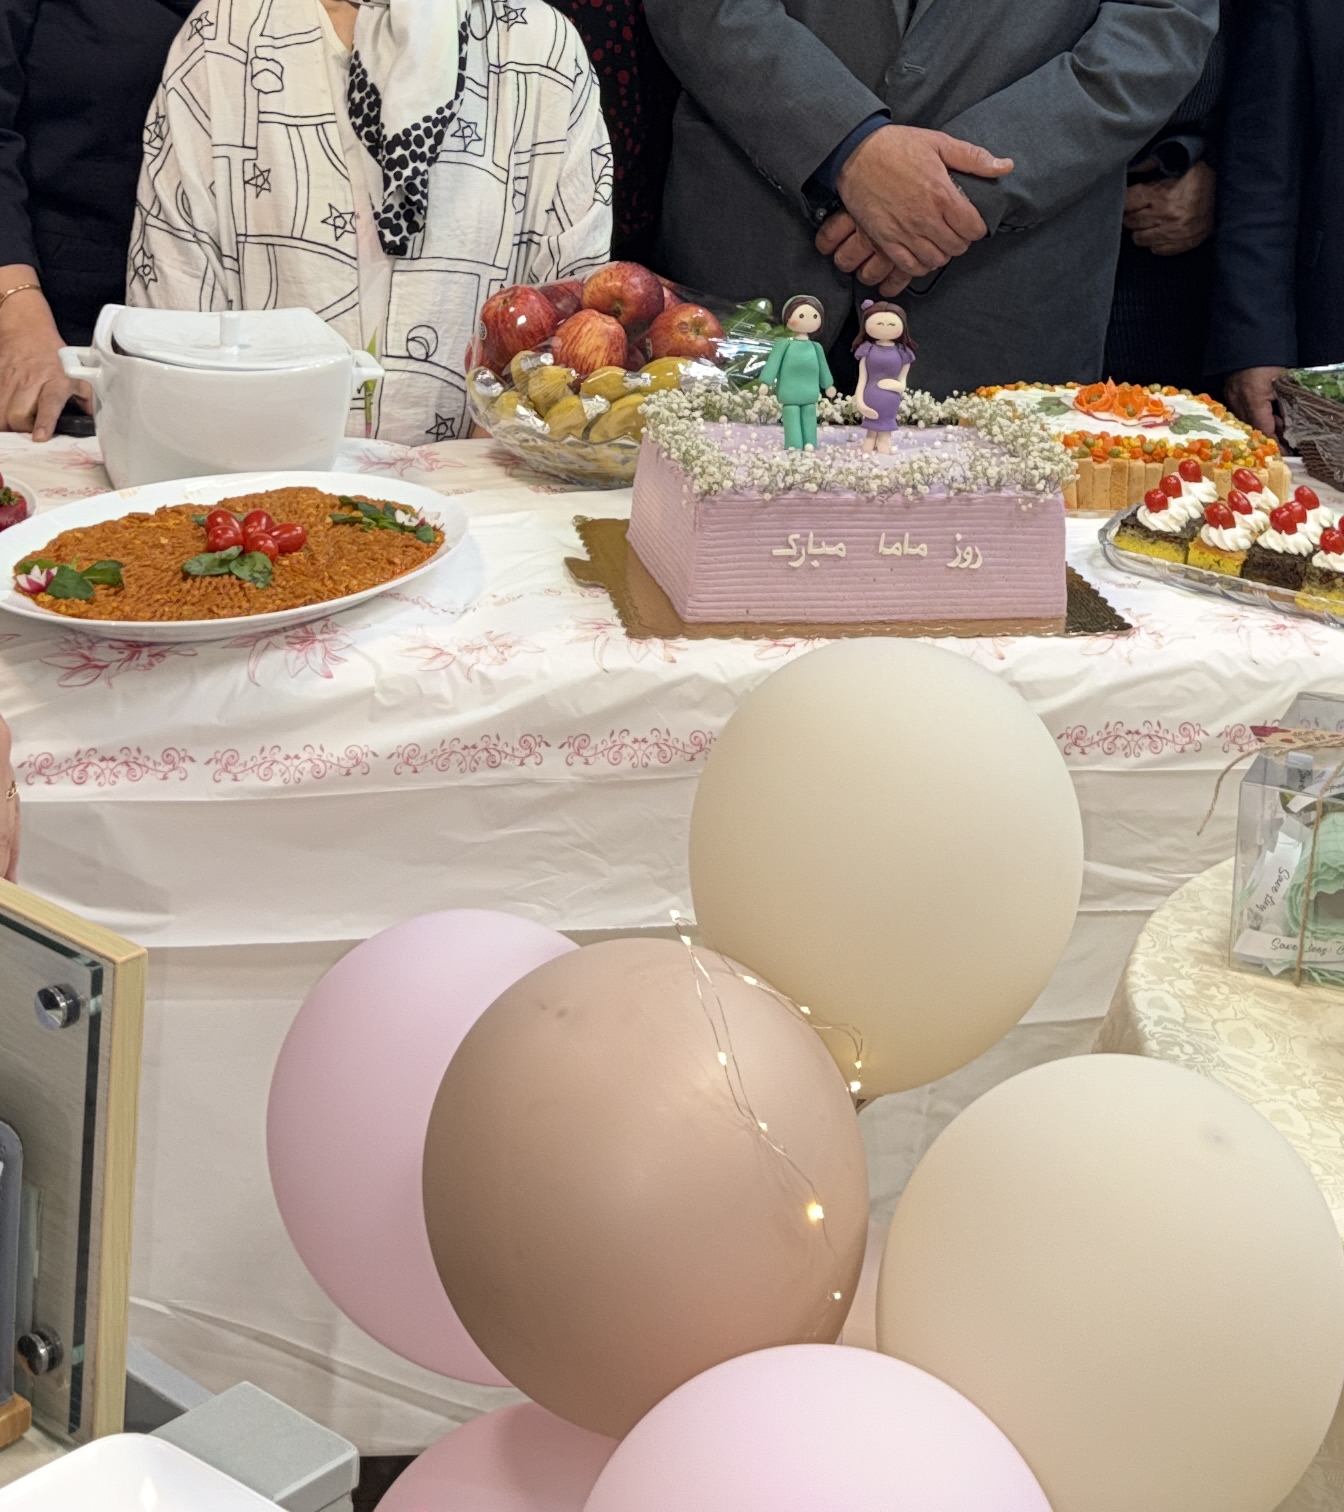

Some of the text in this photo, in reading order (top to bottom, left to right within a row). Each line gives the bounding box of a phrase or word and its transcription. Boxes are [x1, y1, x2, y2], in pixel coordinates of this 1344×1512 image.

[772, 531, 983, 569] روز ماما مبارک
